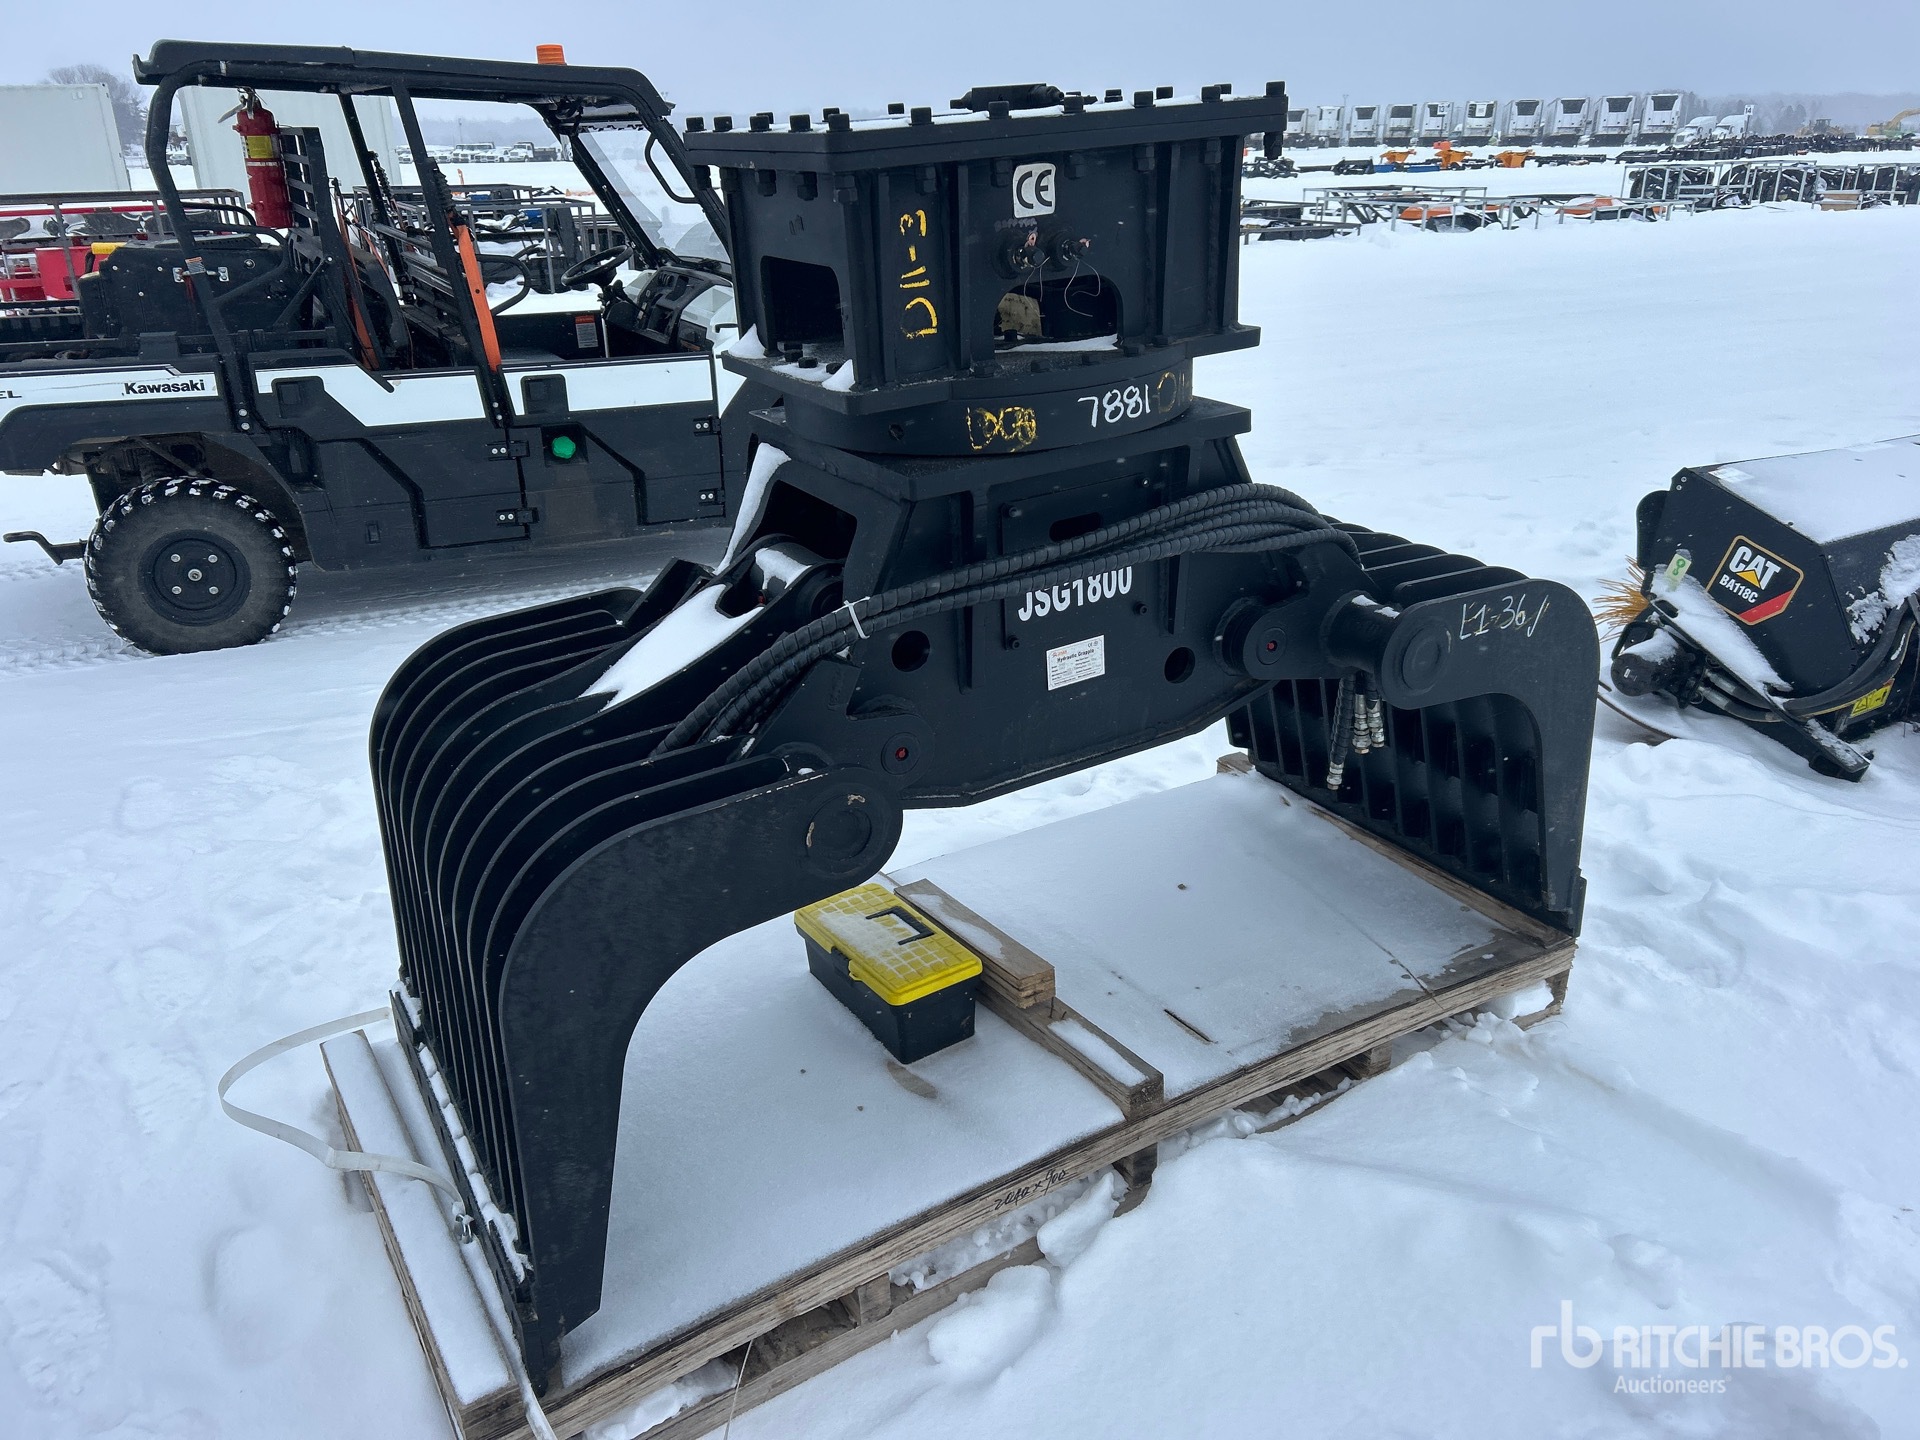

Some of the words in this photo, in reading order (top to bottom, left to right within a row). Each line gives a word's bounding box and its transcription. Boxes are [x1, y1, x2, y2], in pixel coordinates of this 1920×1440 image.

[1016, 169, 1053, 209] CE
[124, 379, 205, 395] Kawasaki
[1078, 384, 1151, 428] 7881
[1719, 574, 1759, 603] BA118C
[1729, 546, 1782, 590] CAT
[1018, 566, 1132, 622] JSG1800
